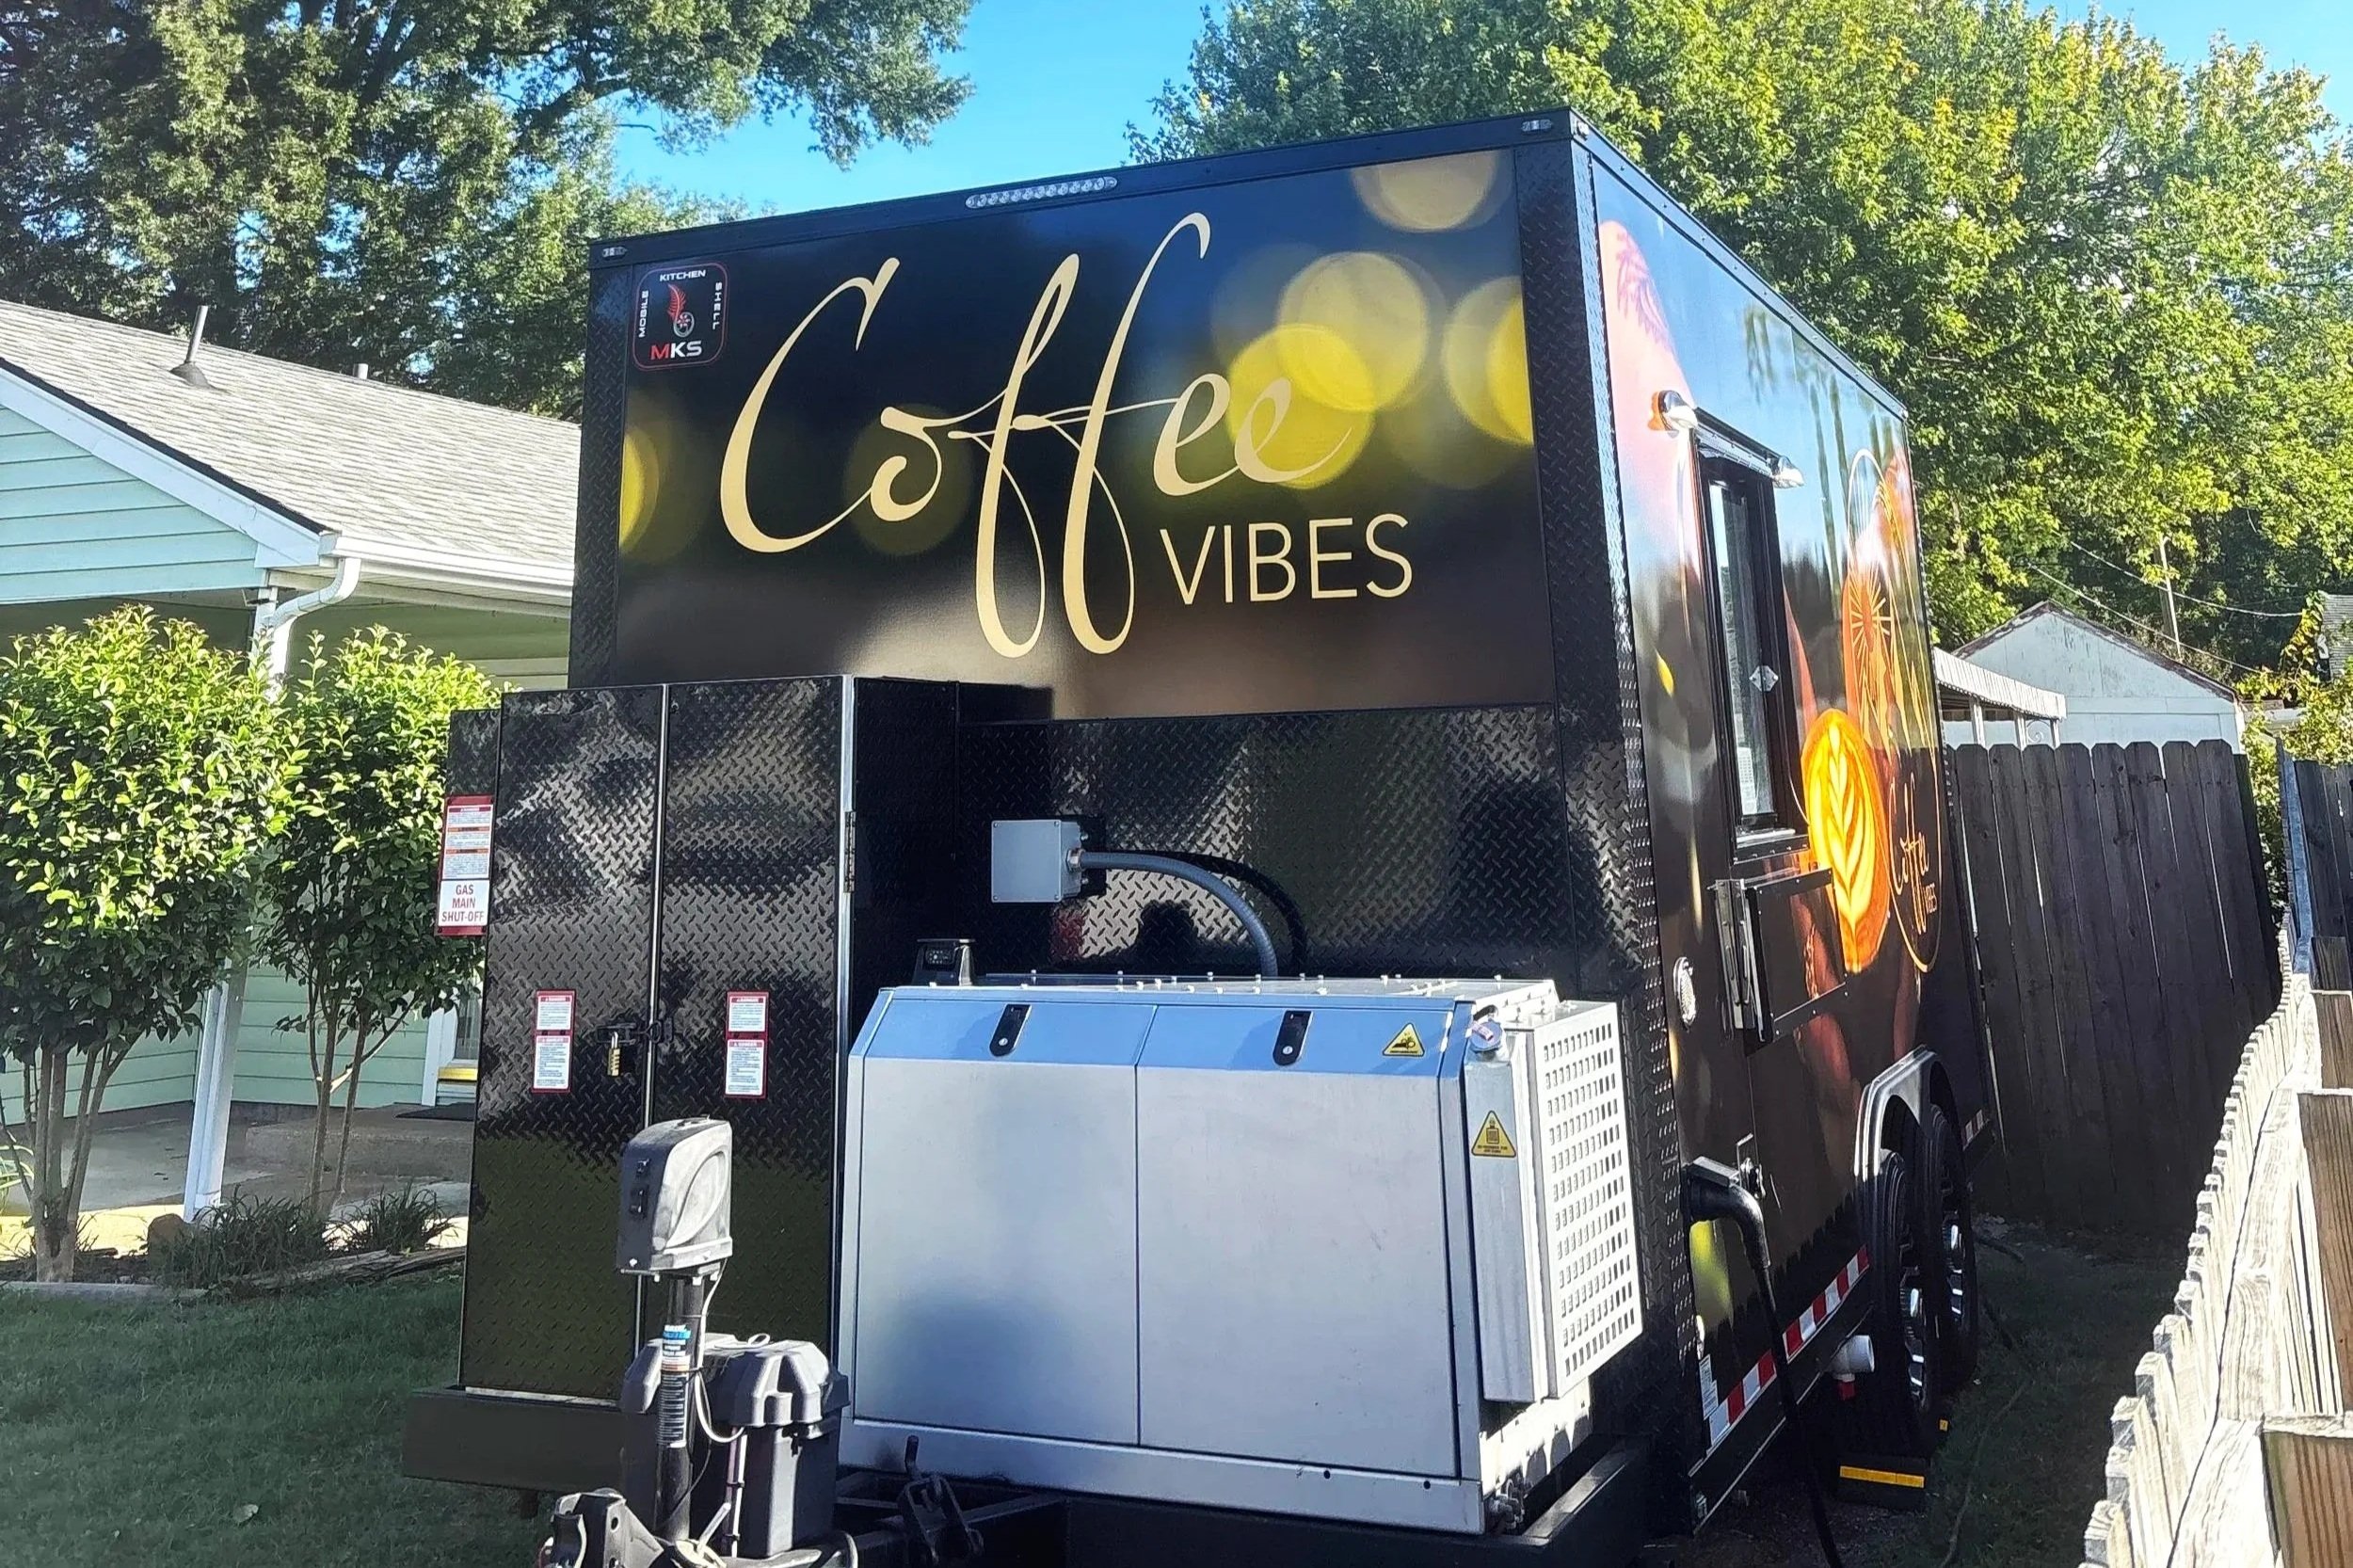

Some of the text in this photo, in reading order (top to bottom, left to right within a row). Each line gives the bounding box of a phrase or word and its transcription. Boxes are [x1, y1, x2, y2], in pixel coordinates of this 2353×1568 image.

[659, 269, 707, 281] KITCHEN
[638, 290, 649, 338] MOBILE
[712, 282, 723, 330] SHELL
[649, 340, 702, 360] MKS
[720, 212, 1353, 659] Coffee
[1160, 513, 1414, 605] VIBES
[456, 884, 474, 895] GAS
[452, 897, 476, 909] MAIN
[441, 910, 484, 922] SHUT-OFF
